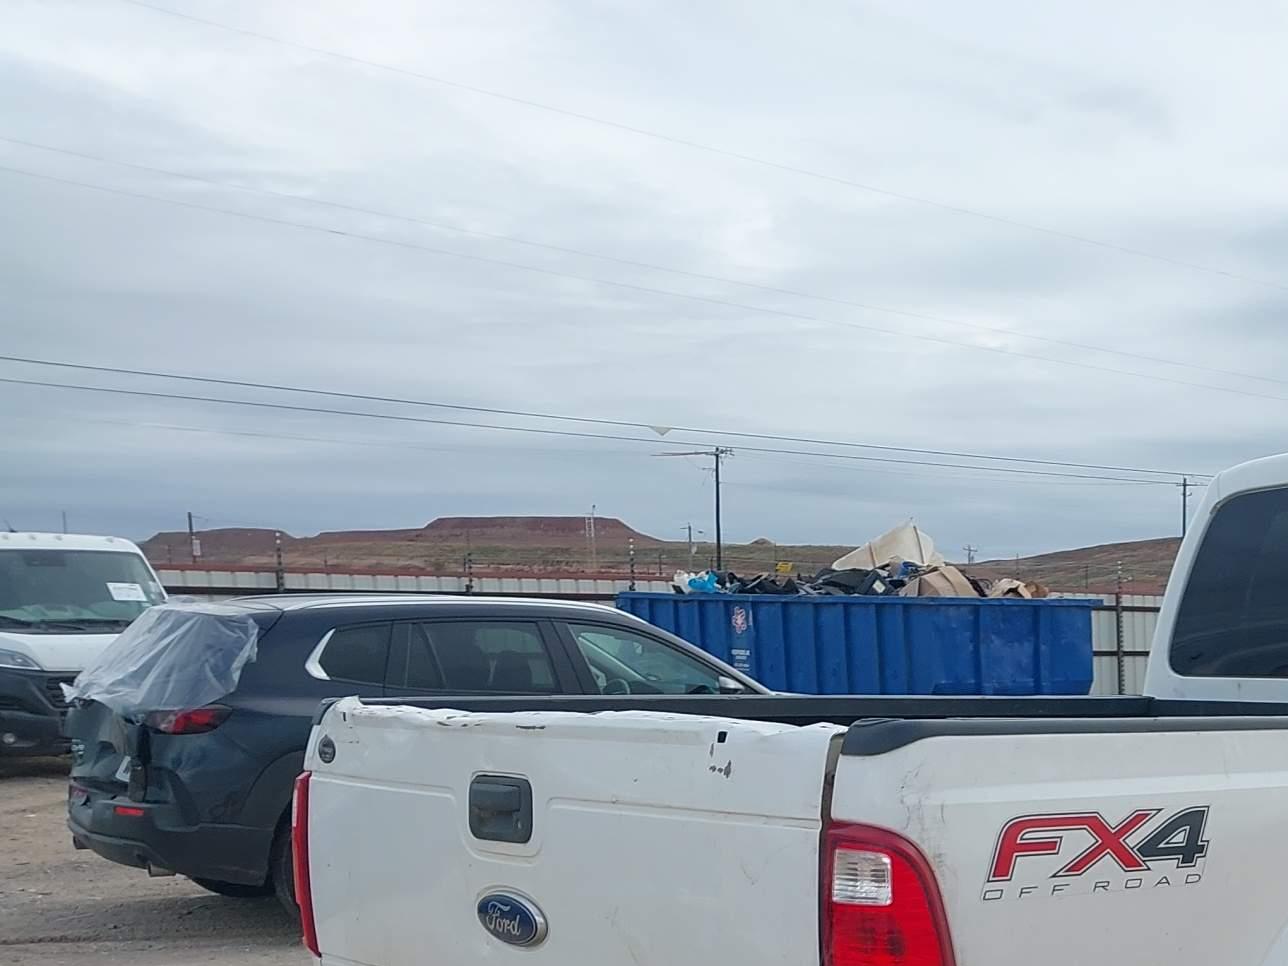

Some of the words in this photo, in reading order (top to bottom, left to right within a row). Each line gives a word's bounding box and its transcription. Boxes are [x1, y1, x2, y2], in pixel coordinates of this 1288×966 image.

[987, 805, 1210, 883] FX4
[982, 883, 1071, 901] OFF
[1092, 873, 1203, 892] ROAD
[486, 901, 521, 936] Ford
